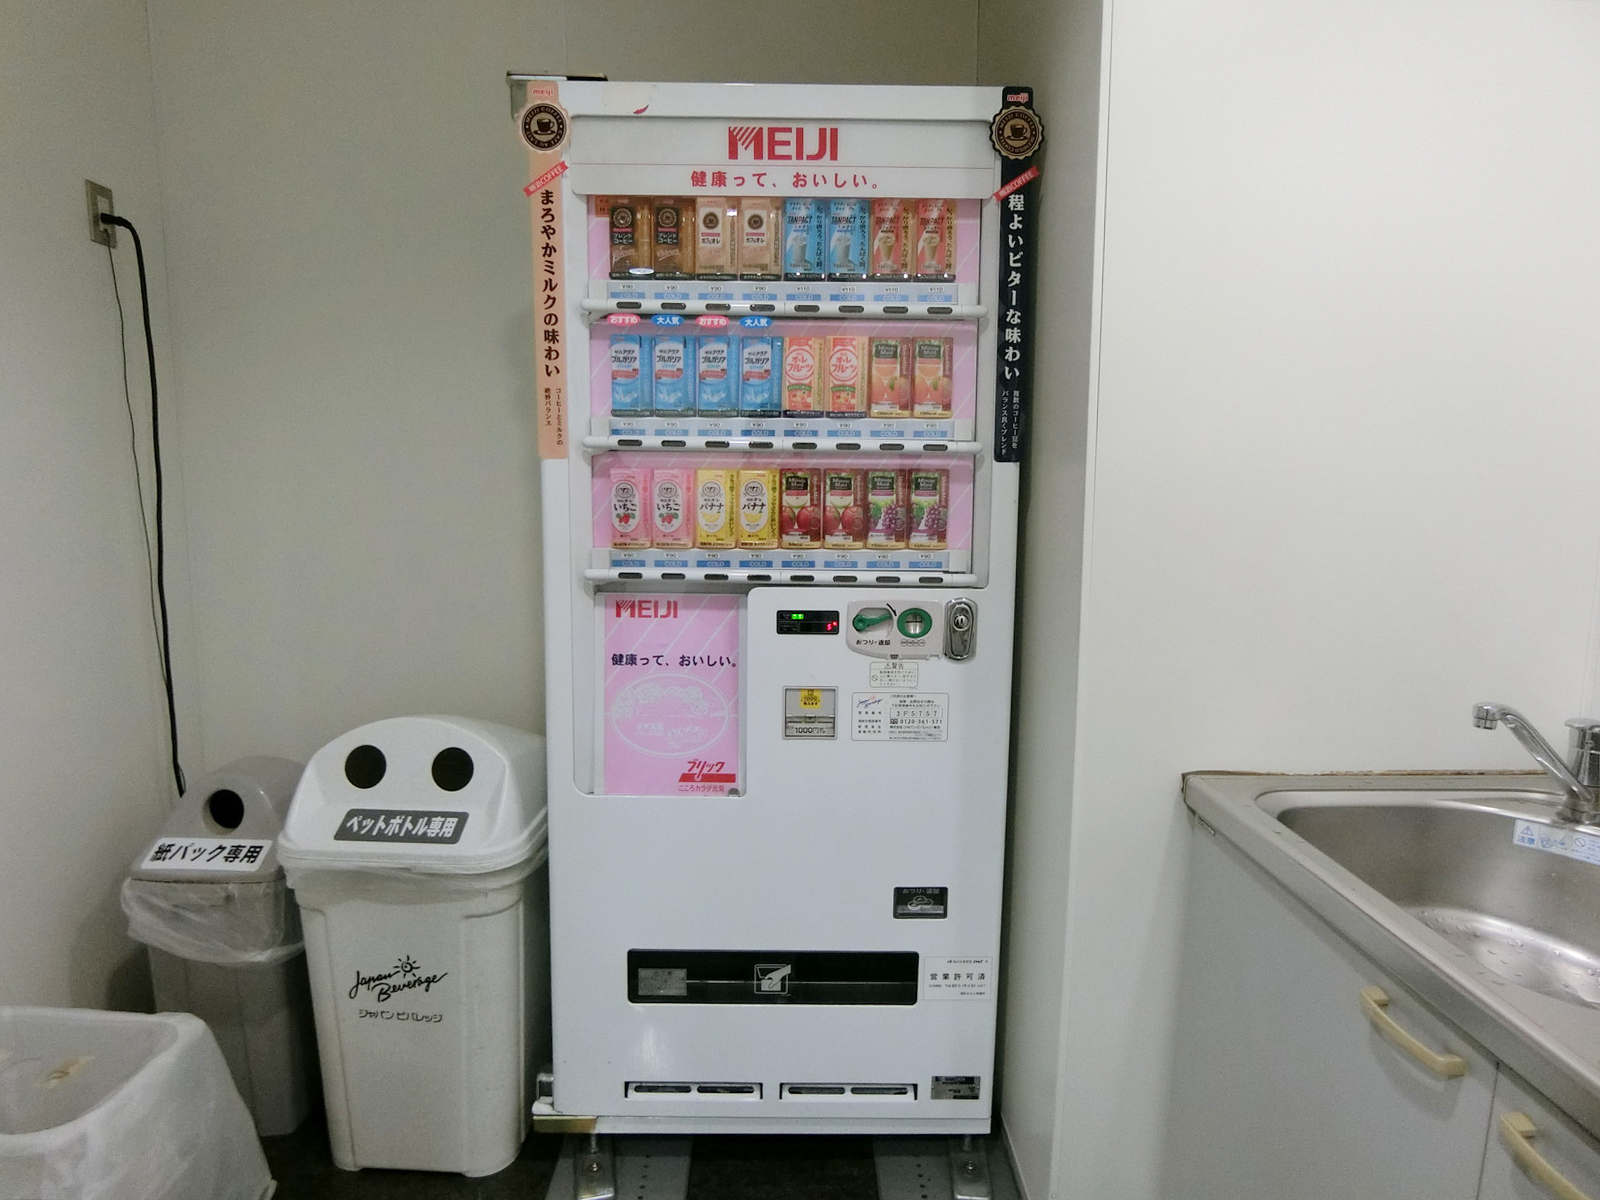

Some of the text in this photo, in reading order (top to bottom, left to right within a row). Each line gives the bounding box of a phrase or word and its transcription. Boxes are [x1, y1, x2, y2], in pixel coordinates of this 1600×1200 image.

[533, 88, 553, 96] meiji
[1008, 94, 1029, 103] meiji
[728, 127, 839, 161] MEIJI
[691, 171, 878, 190] 健康って、おいしい。
[541, 190, 560, 377] まろやかミルクの味わい
[1005, 194, 1024, 380] 程よいビターな味わい
[657, 317, 680, 325] 大人気
[745, 318, 768, 326] 大人気
[787, 364, 813, 372] フルーツ
[831, 364, 857, 373] フルーツ
[614, 503, 637, 511] いちご
[657, 503, 680, 511] いちご
[700, 503, 724, 511] バナナ
[742, 502, 766, 511] バナナ
[616, 600, 678, 619] MEIJI
[612, 653, 737, 668] 健康って、おいしい。
[687, 759, 725, 779] ブリック
[346, 815, 458, 838] ペットボトル専用
[149, 844, 265, 864] 紙パック専用
[349, 971, 400, 1000] Japan
[372, 973, 448, 1003] Beverage
